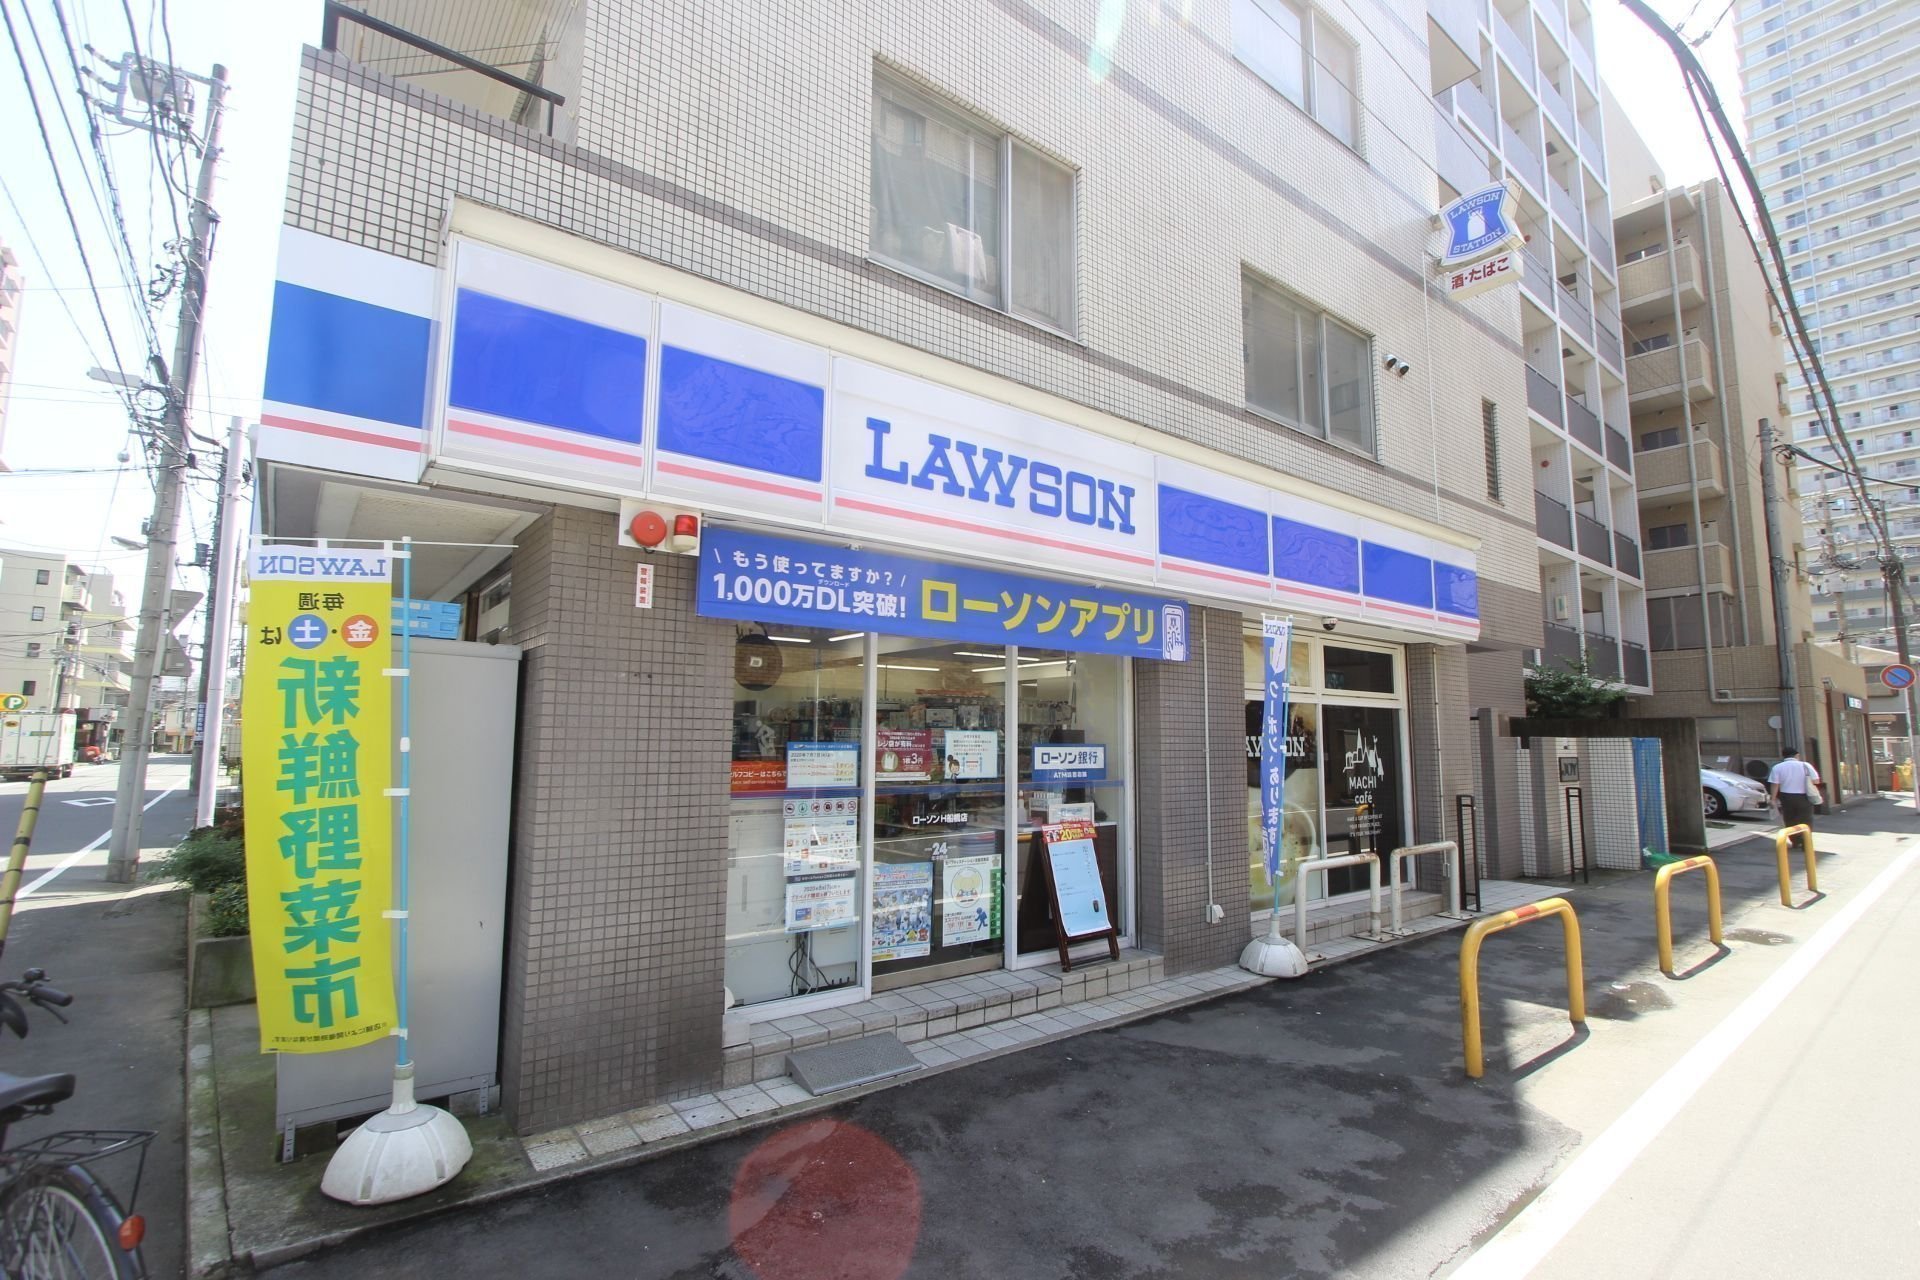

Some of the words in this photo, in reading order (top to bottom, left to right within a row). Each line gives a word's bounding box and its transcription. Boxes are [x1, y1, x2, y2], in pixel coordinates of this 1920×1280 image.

[1449, 192, 1501, 219] LAWSON
[1453, 228, 1502, 254] STATION
[865, 417, 1136, 535] LAWSON
[713, 573, 906, 618] 1,000万DL突破!
[922, 579, 1155, 645] ローソンアプリ
[8, 697, 22, 709] P
[1041, 751, 1098, 765] ローソン銀行
[1349, 776, 1377, 790] MACHI
[1355, 791, 1373, 804] café
[932, 842, 948, 855] 24
